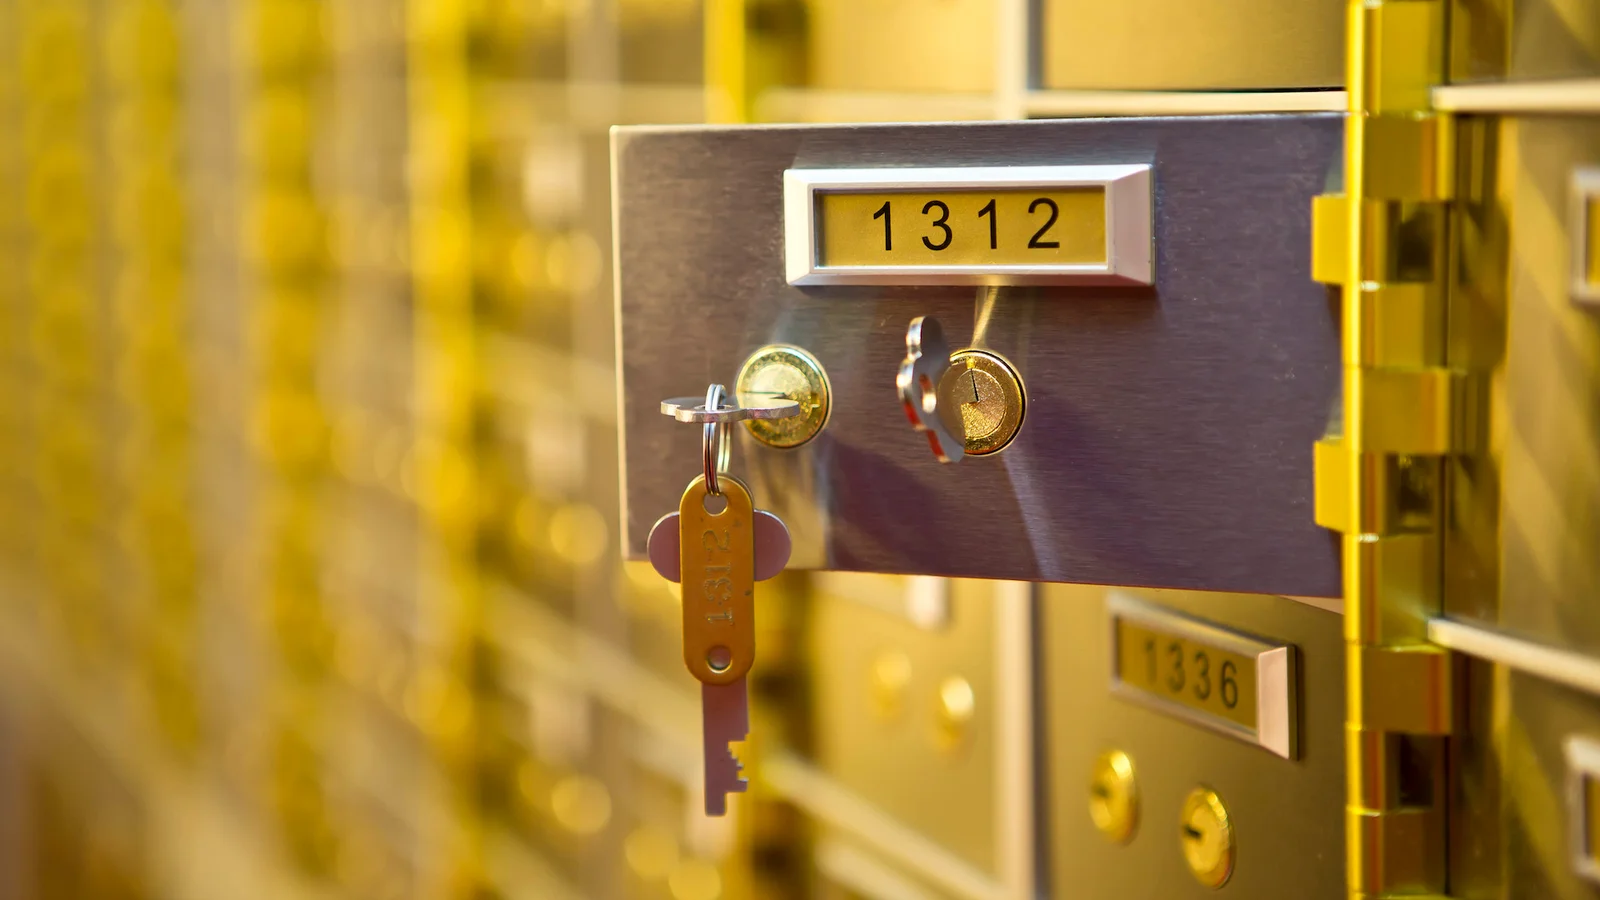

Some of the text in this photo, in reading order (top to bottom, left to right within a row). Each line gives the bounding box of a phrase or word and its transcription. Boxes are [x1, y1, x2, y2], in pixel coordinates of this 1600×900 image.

[873, 198, 1060, 251] 1312
[703, 529, 732, 625] 1312
[1145, 638, 1238, 709] 1336
